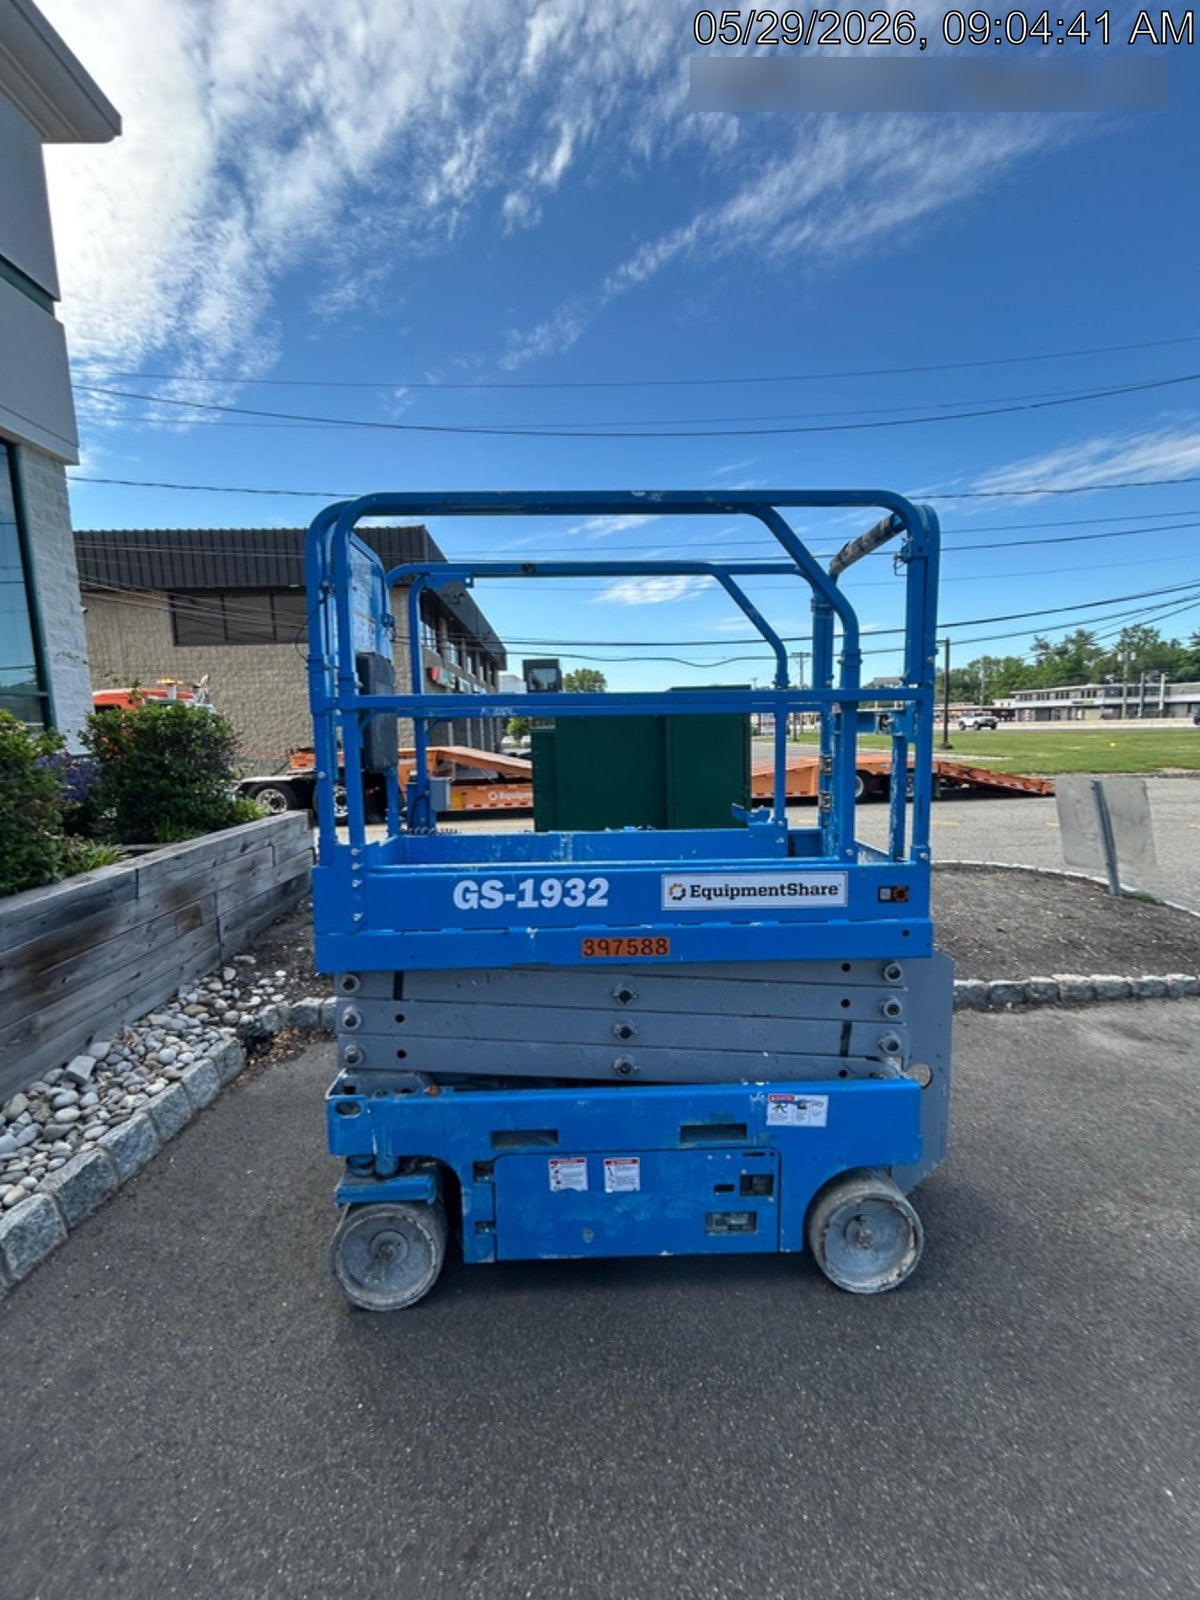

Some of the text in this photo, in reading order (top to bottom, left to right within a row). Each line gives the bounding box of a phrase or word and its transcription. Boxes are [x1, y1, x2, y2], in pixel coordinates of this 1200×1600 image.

[453, 877, 609, 910] GS-1932
[690, 882, 839, 900] EquipmentShare
[583, 938, 668, 956] 397588
